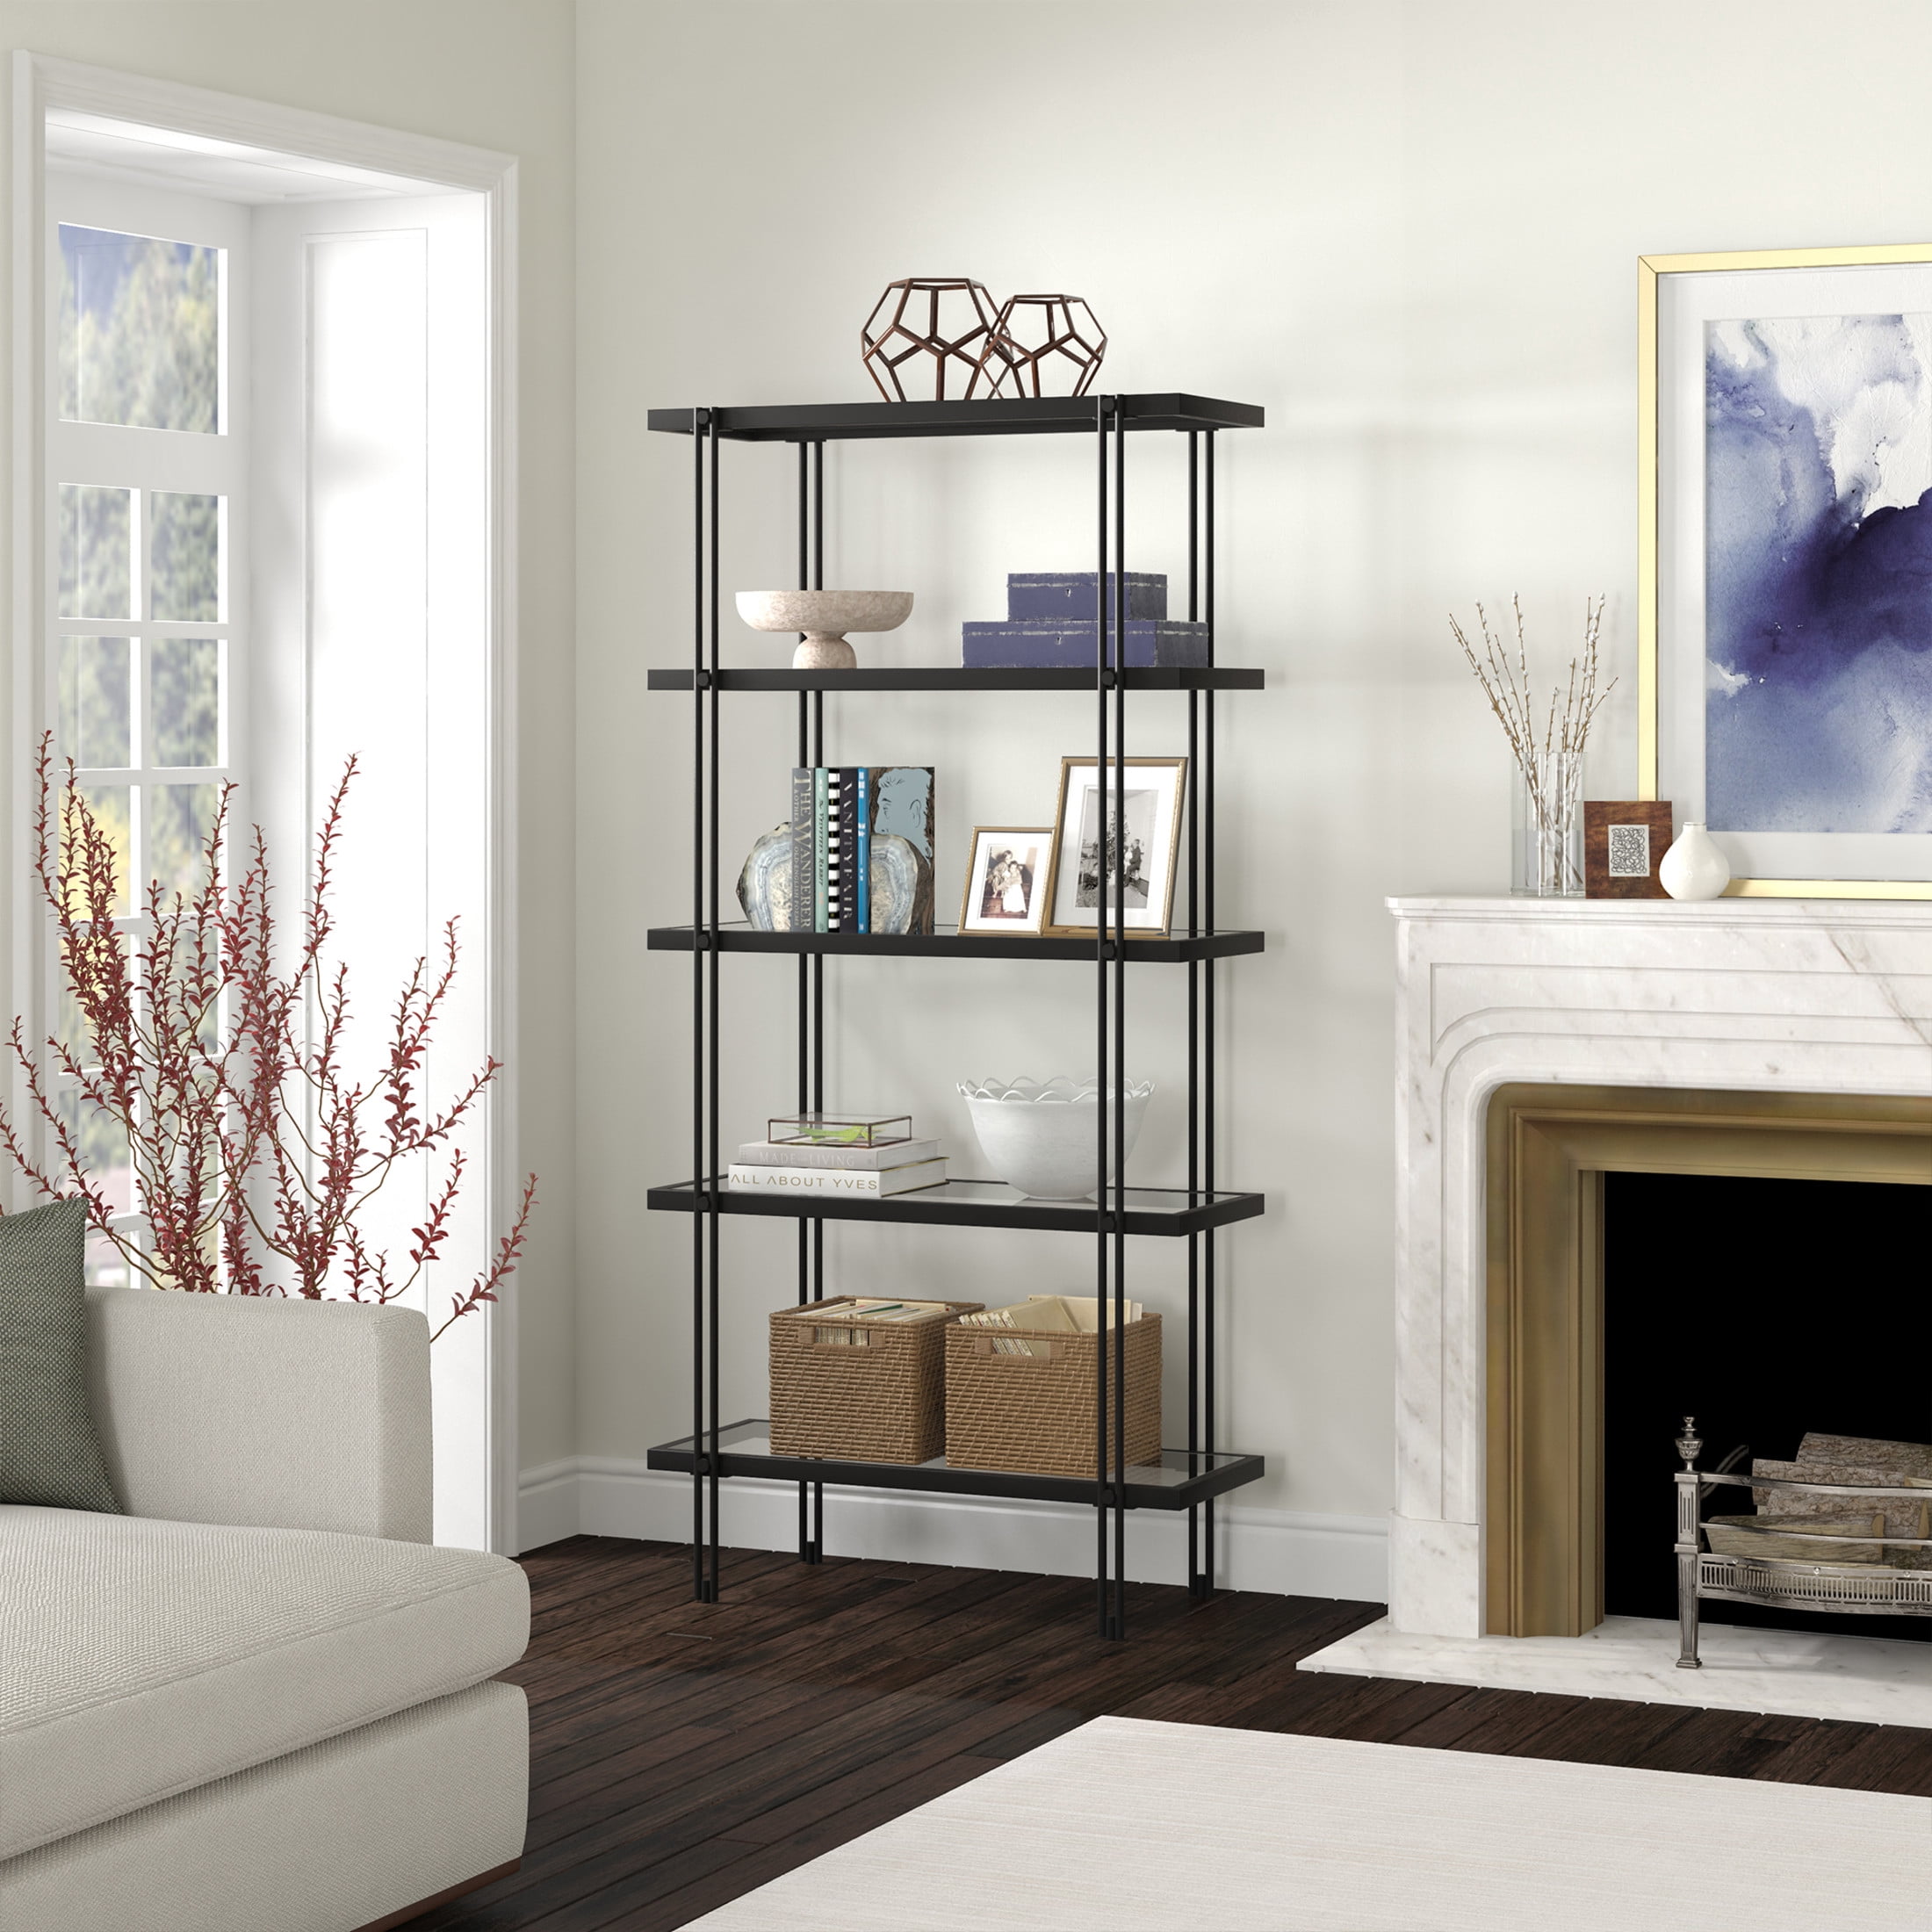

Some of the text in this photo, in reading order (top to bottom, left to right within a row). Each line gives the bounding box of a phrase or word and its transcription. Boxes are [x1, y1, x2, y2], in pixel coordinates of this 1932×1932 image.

[794, 769, 811, 928] THE WANDERER
[759, 1151, 797, 1165] MADE
[809, 1153, 855, 1167] LIVING
[731, 1173, 877, 1190] ALL ABOUT YVES
